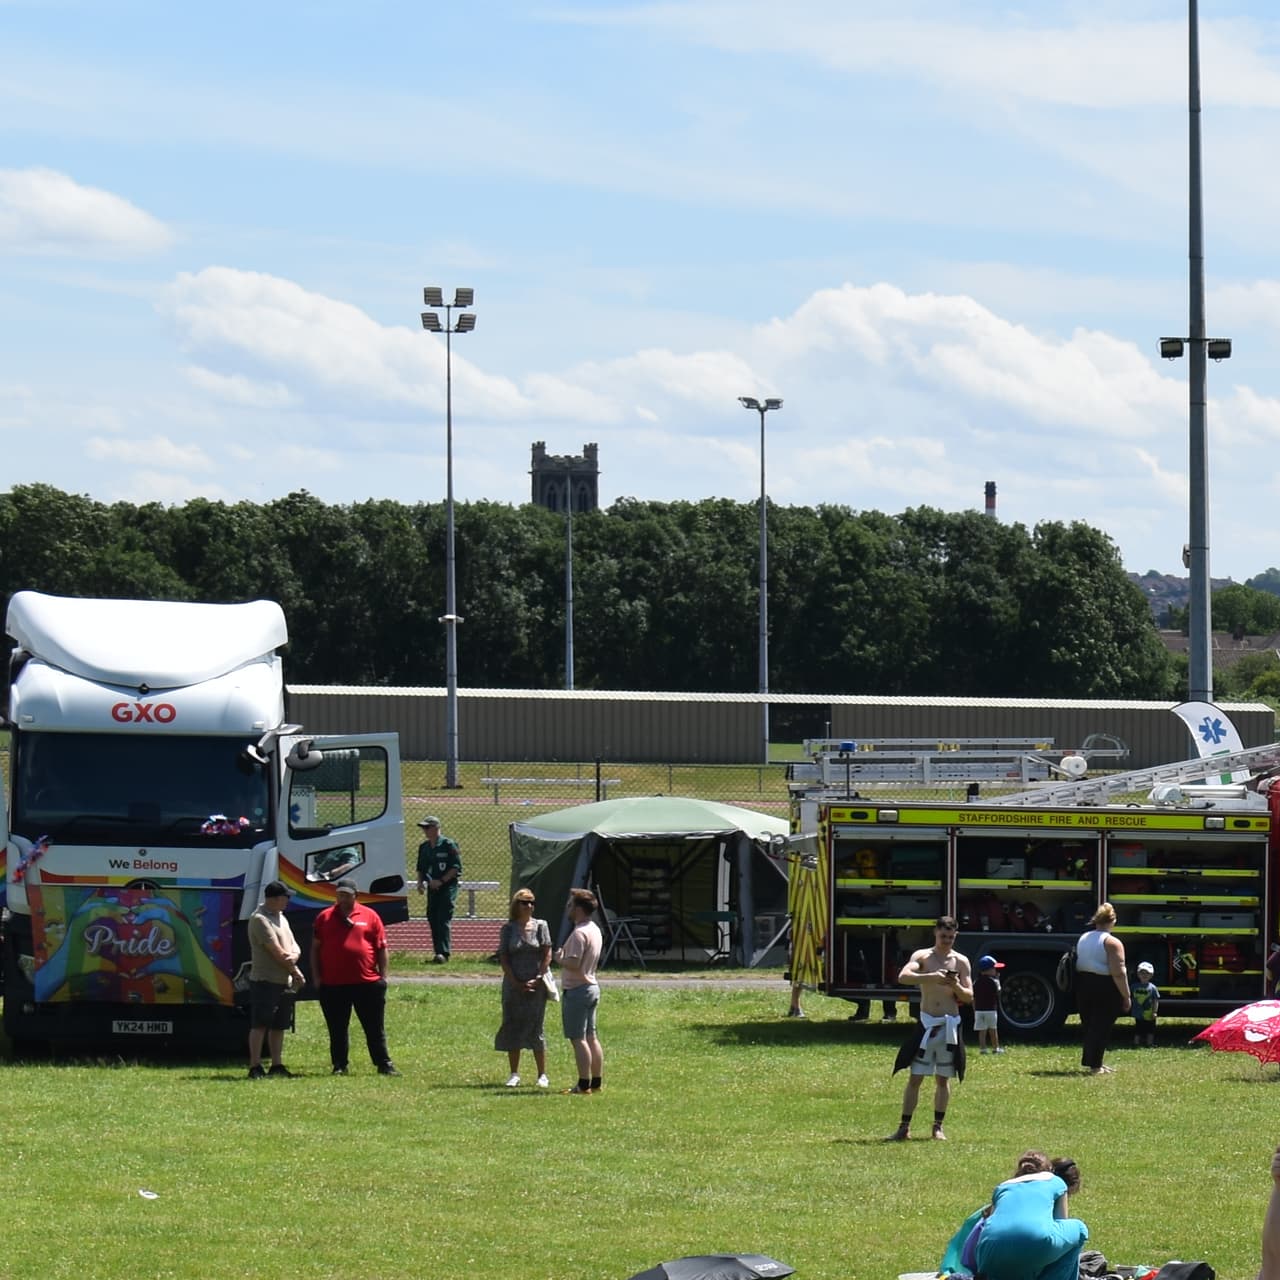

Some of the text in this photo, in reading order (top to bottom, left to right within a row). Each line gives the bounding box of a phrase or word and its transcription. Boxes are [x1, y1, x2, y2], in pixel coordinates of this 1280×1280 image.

[111, 702, 177, 723] GXO
[958, 813, 1147, 826] STAFFORDSHIRE FIRE AND RESCUE
[108, 859, 178, 872] We Belong
[83, 925, 174, 956] Pride
[116, 1022, 144, 1032] YK24
